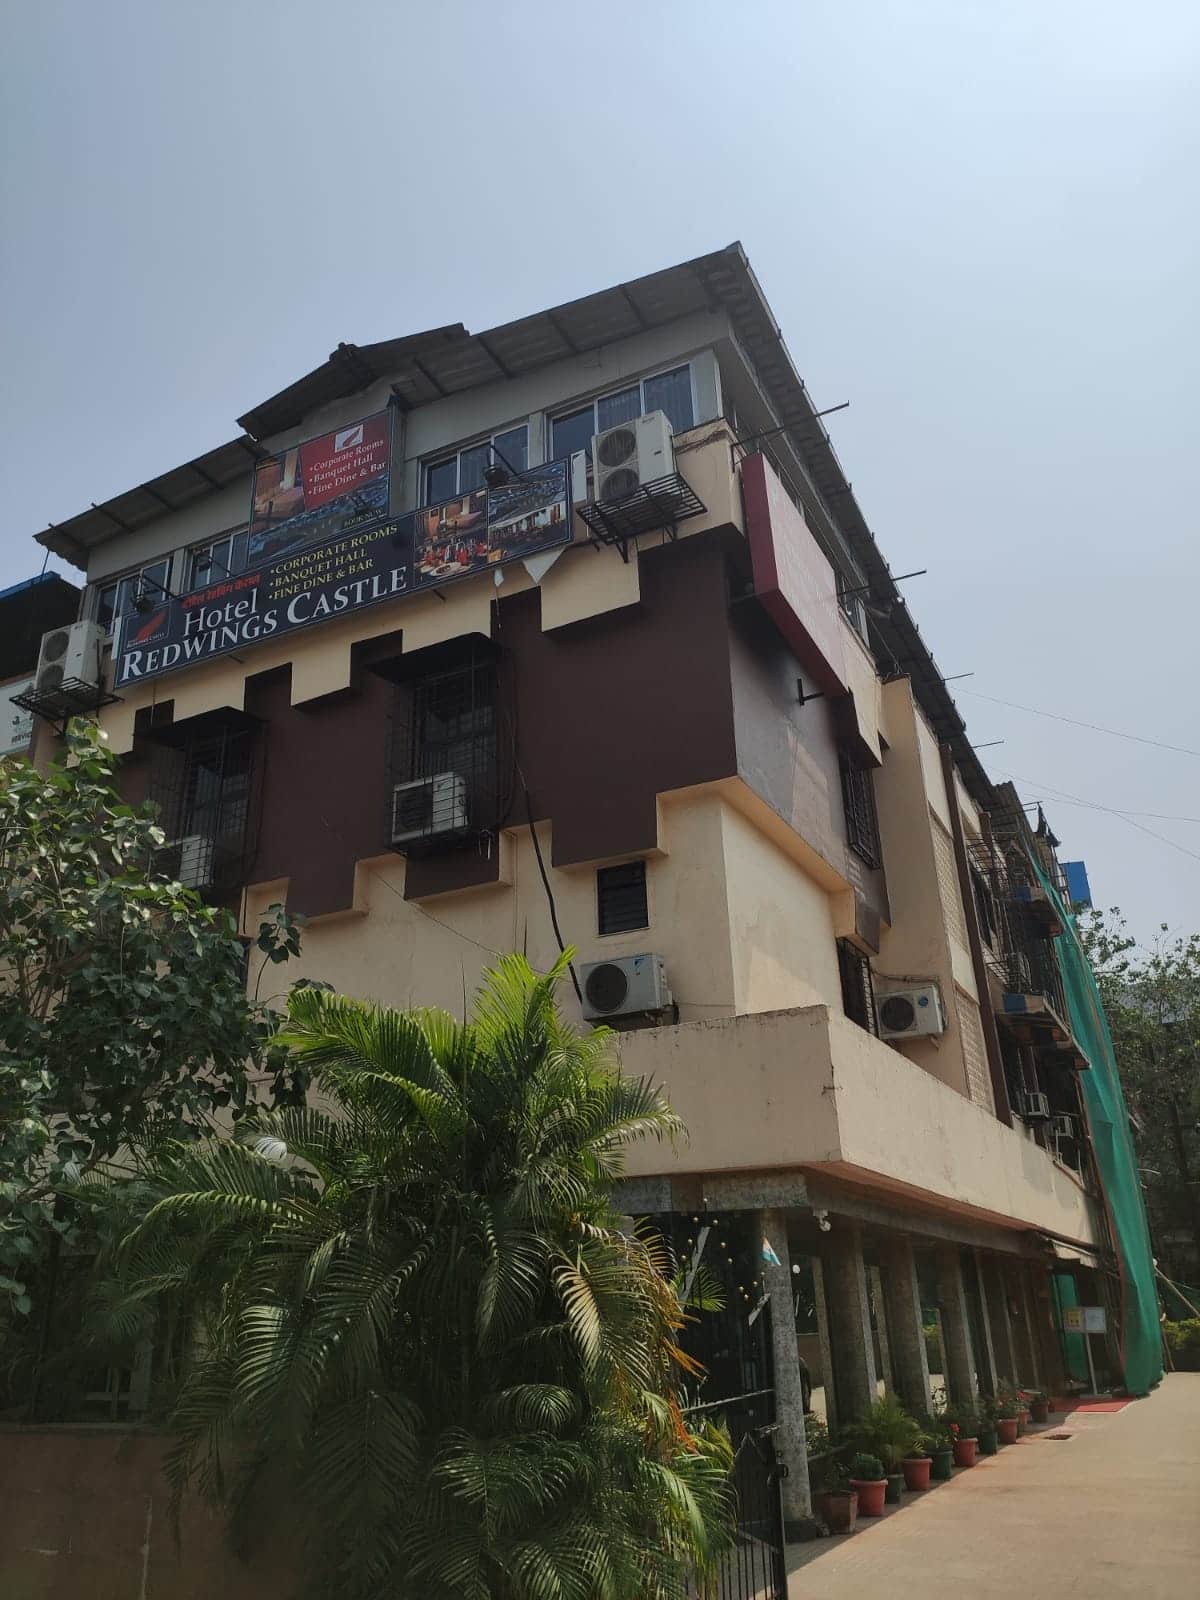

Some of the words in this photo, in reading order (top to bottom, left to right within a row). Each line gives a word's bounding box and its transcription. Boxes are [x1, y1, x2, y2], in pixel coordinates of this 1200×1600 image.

[313, 451, 353, 471] Corporate
[355, 440, 384, 454] Rooms
[314, 462, 351, 482] Banquet
[353, 453, 373, 467] Hall
[313, 482, 333, 495] Fine
[335, 473, 357, 487] Dine
[359, 468, 368, 476] &
[370, 462, 386, 472] Bar
[274, 560, 332, 587] BANQUET
[335, 548, 367, 566] HALL
[275, 542, 348, 574] CORPORATE
[351, 524, 398, 548] ROOMS
[274, 585, 300, 600] FINE
[303, 573, 333, 590] DINE
[336, 569, 346, 579] &
[349, 558, 374, 574] BAR
[120, 609, 277, 682] REDWINGS
[287, 567, 407, 624] CASTLE
[183, 588, 258, 637] Hotel
